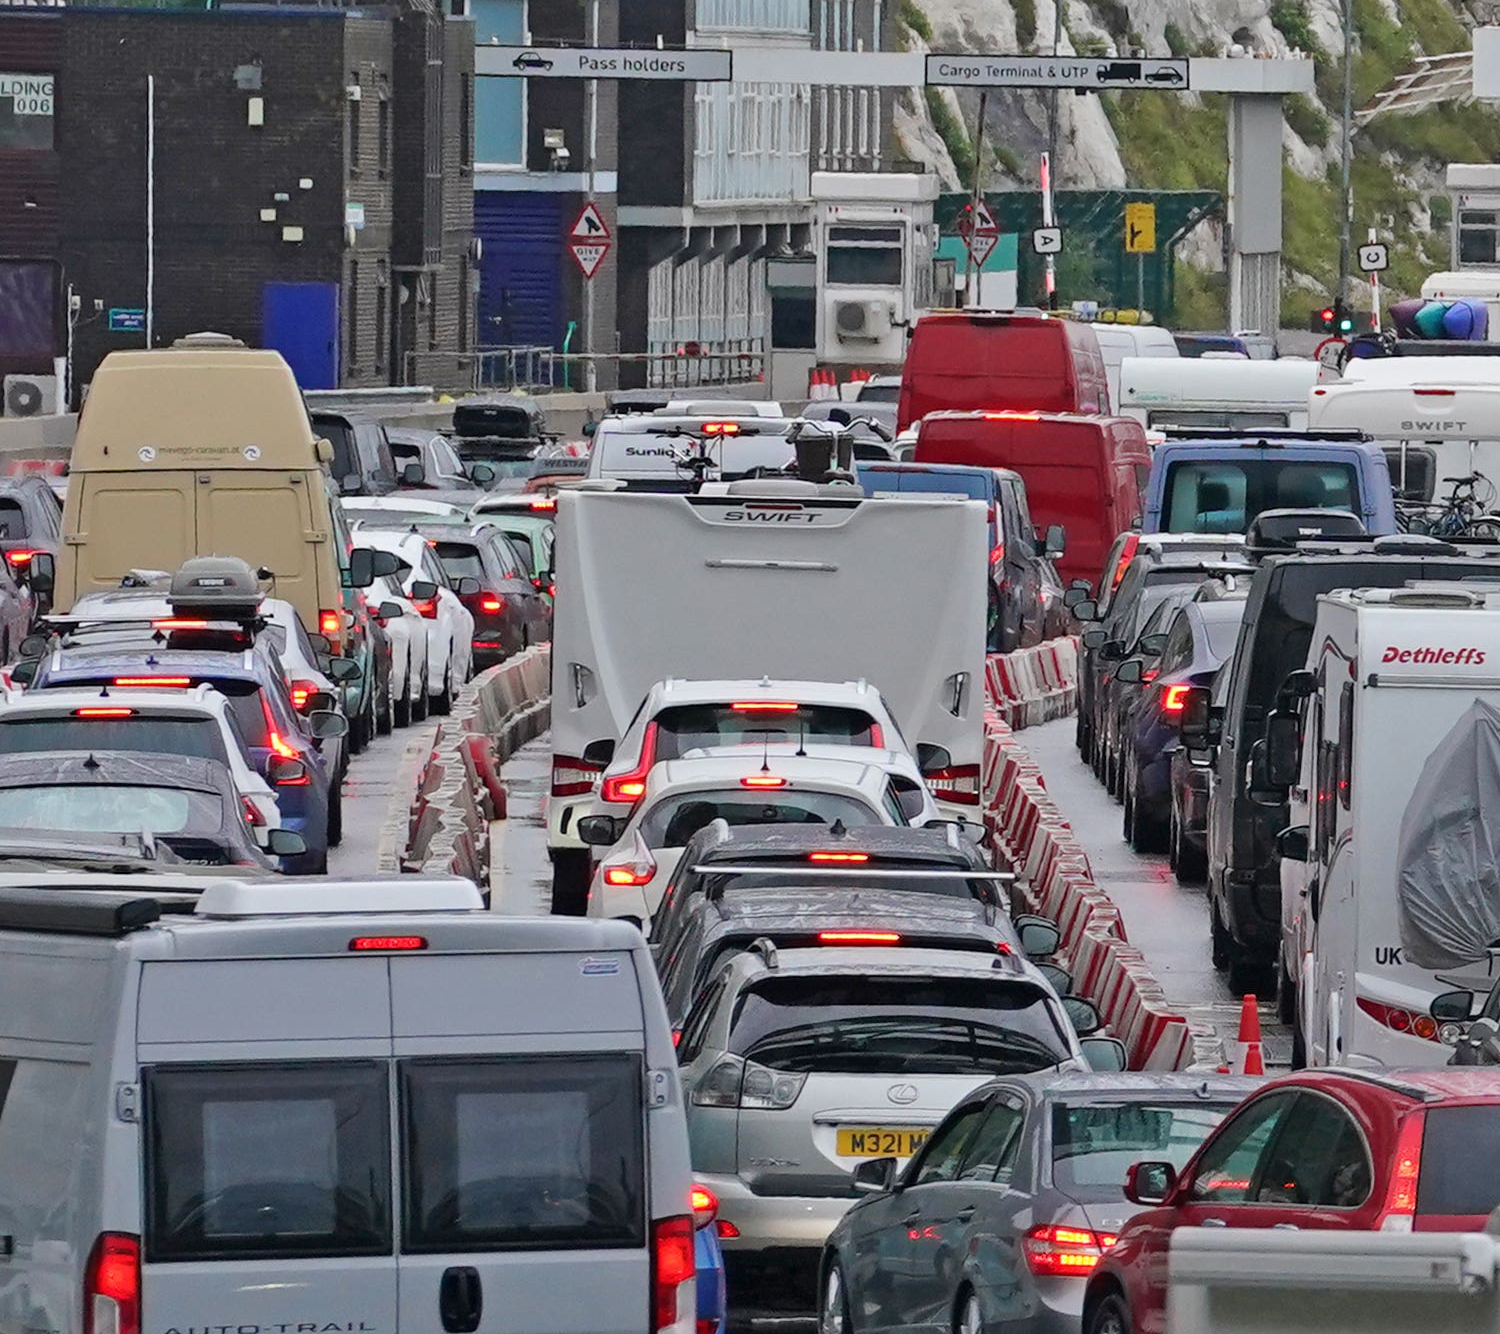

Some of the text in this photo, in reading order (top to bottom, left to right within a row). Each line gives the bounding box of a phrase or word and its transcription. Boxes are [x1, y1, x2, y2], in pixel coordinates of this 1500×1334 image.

[579, 57, 685, 72] Pass holders
[939, 64, 1089, 79] Cargo Terminal & UTP
[17, 99, 49, 112] 006
[1041, 235, 1054, 247] A
[1366, 252, 1380, 264] C
[1400, 420, 1468, 433] SWIFT
[724, 511, 823, 523] SWIFT
[1381, 646, 1486, 666] Dethleffs
[1375, 947, 1402, 965] UK
[851, 1134, 902, 1154] M321
